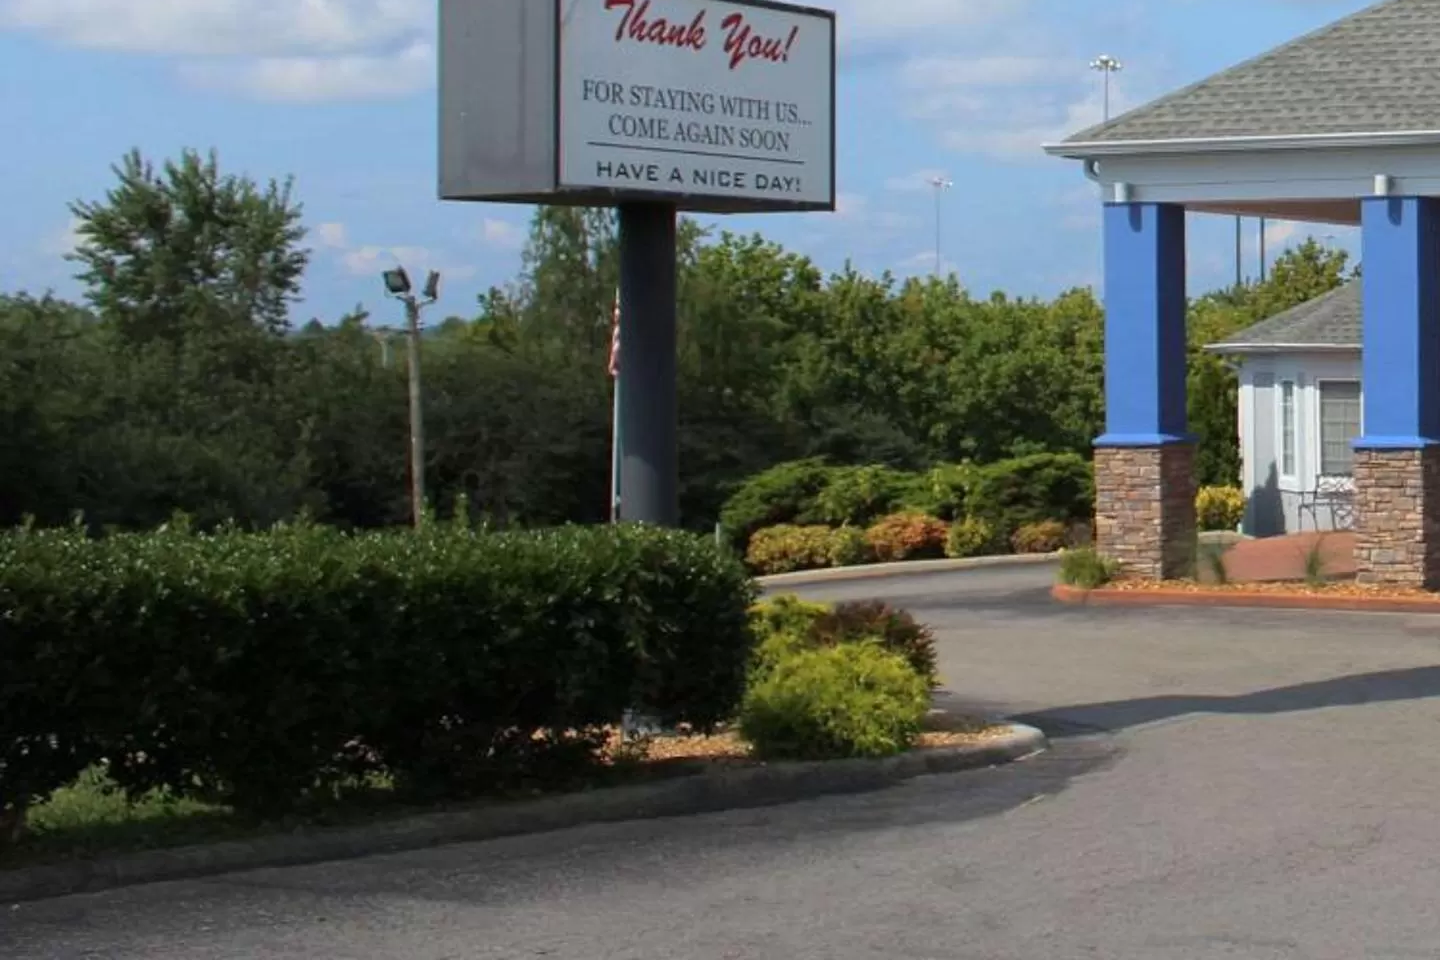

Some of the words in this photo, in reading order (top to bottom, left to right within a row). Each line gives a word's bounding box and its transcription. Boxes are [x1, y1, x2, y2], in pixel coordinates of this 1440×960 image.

[721, 12, 799, 70] You!
[583, 78, 625, 105] FOR
[630, 85, 715, 115] STAYING
[720, 95, 770, 121] WITH
[608, 113, 670, 142] COME
[673, 122, 735, 148] AGAIN
[739, 129, 791, 152] SOON
[596, 160, 659, 182] HAVE
[669, 168, 684, 185] A
[692, 169, 746, 190] NICE
[755, 173, 802, 194] DAY!
